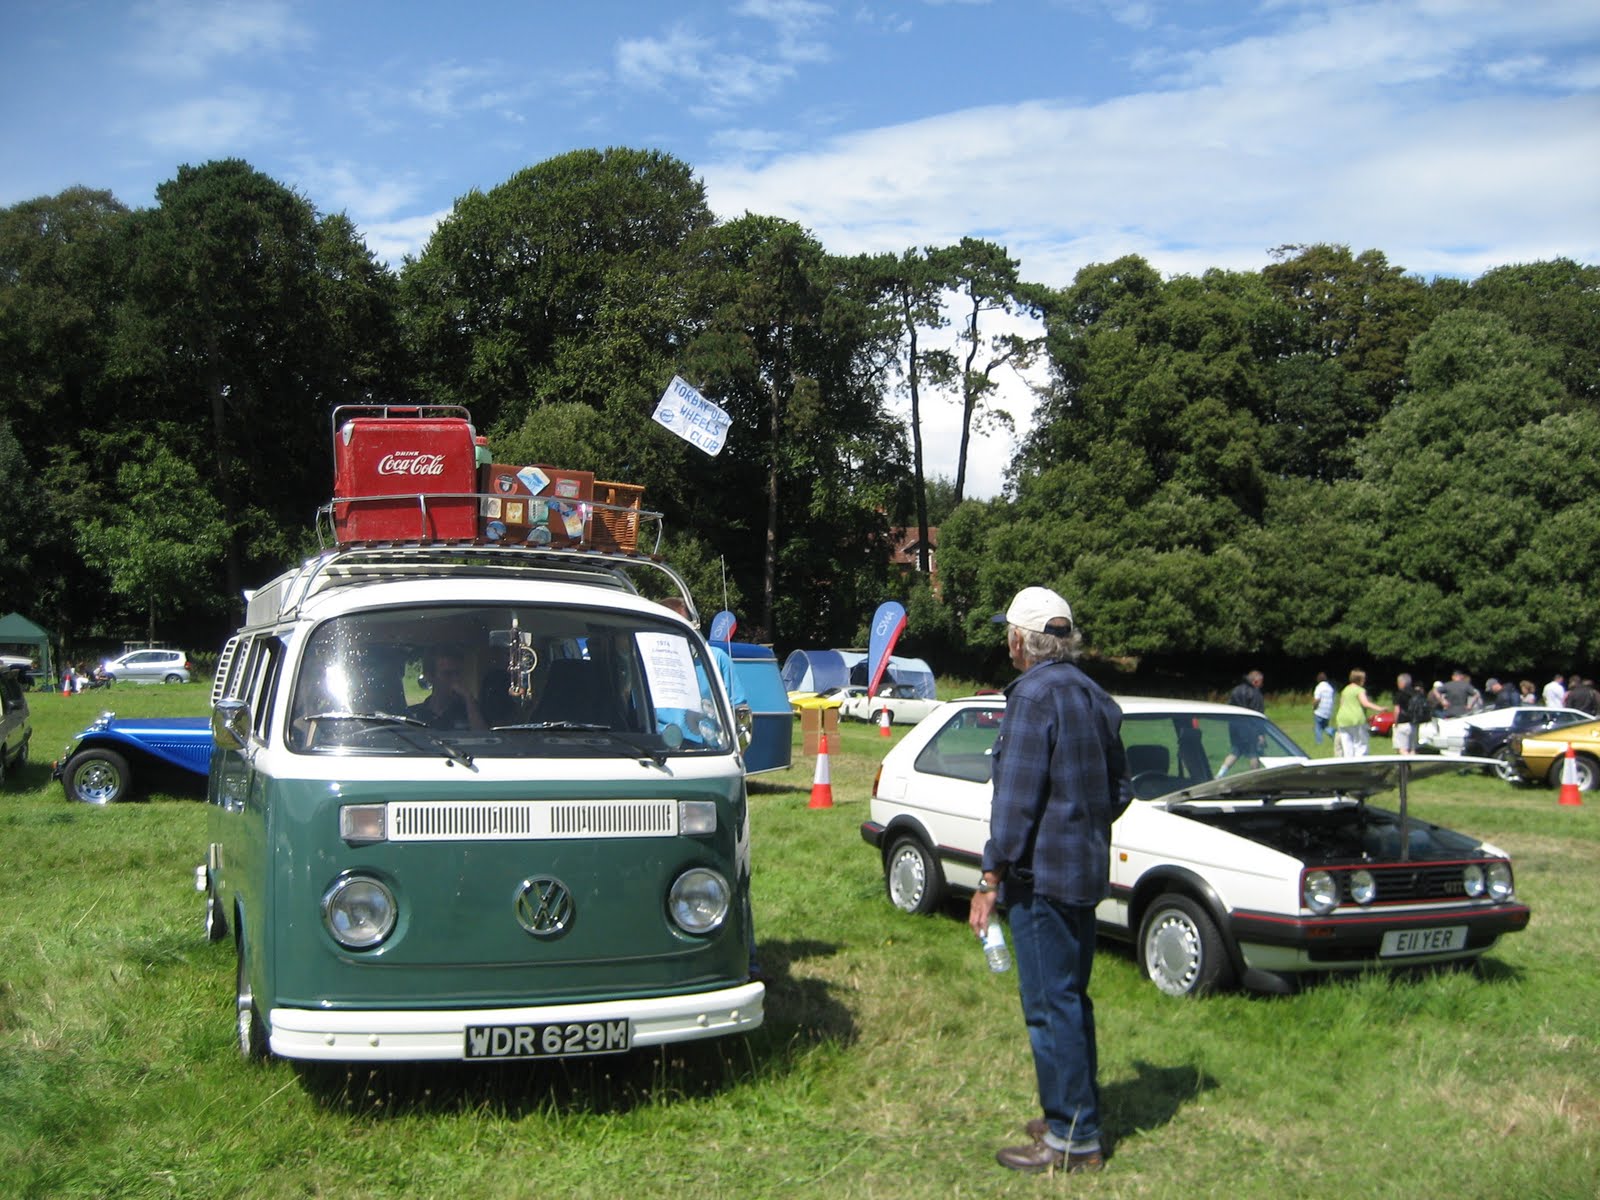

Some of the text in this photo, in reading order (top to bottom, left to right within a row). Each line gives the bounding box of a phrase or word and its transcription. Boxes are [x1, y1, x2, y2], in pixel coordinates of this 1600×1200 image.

[673, 382, 708, 412] TORBAY
[680, 404, 721, 436] WHEELS
[689, 430, 720, 453] CLUB
[378, 454, 446, 475] Coca-Cola
[1422, 930, 1453, 950] YER
[469, 1020, 627, 1056] WDR 629M
